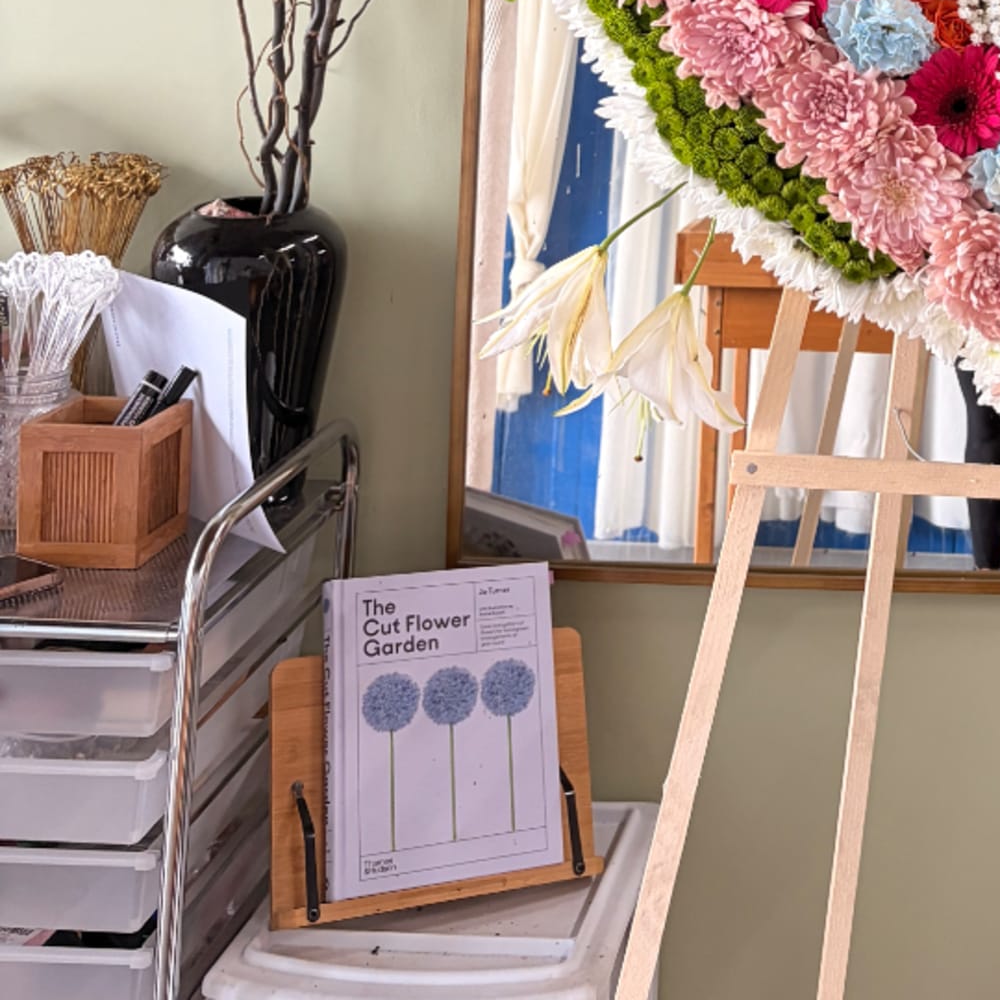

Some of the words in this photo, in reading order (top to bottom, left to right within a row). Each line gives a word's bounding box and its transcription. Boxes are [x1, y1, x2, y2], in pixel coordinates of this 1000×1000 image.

[362, 598, 396, 617] The
[363, 618, 401, 637] Cut
[405, 613, 471, 633] Flower
[363, 635, 440, 657] Garden
